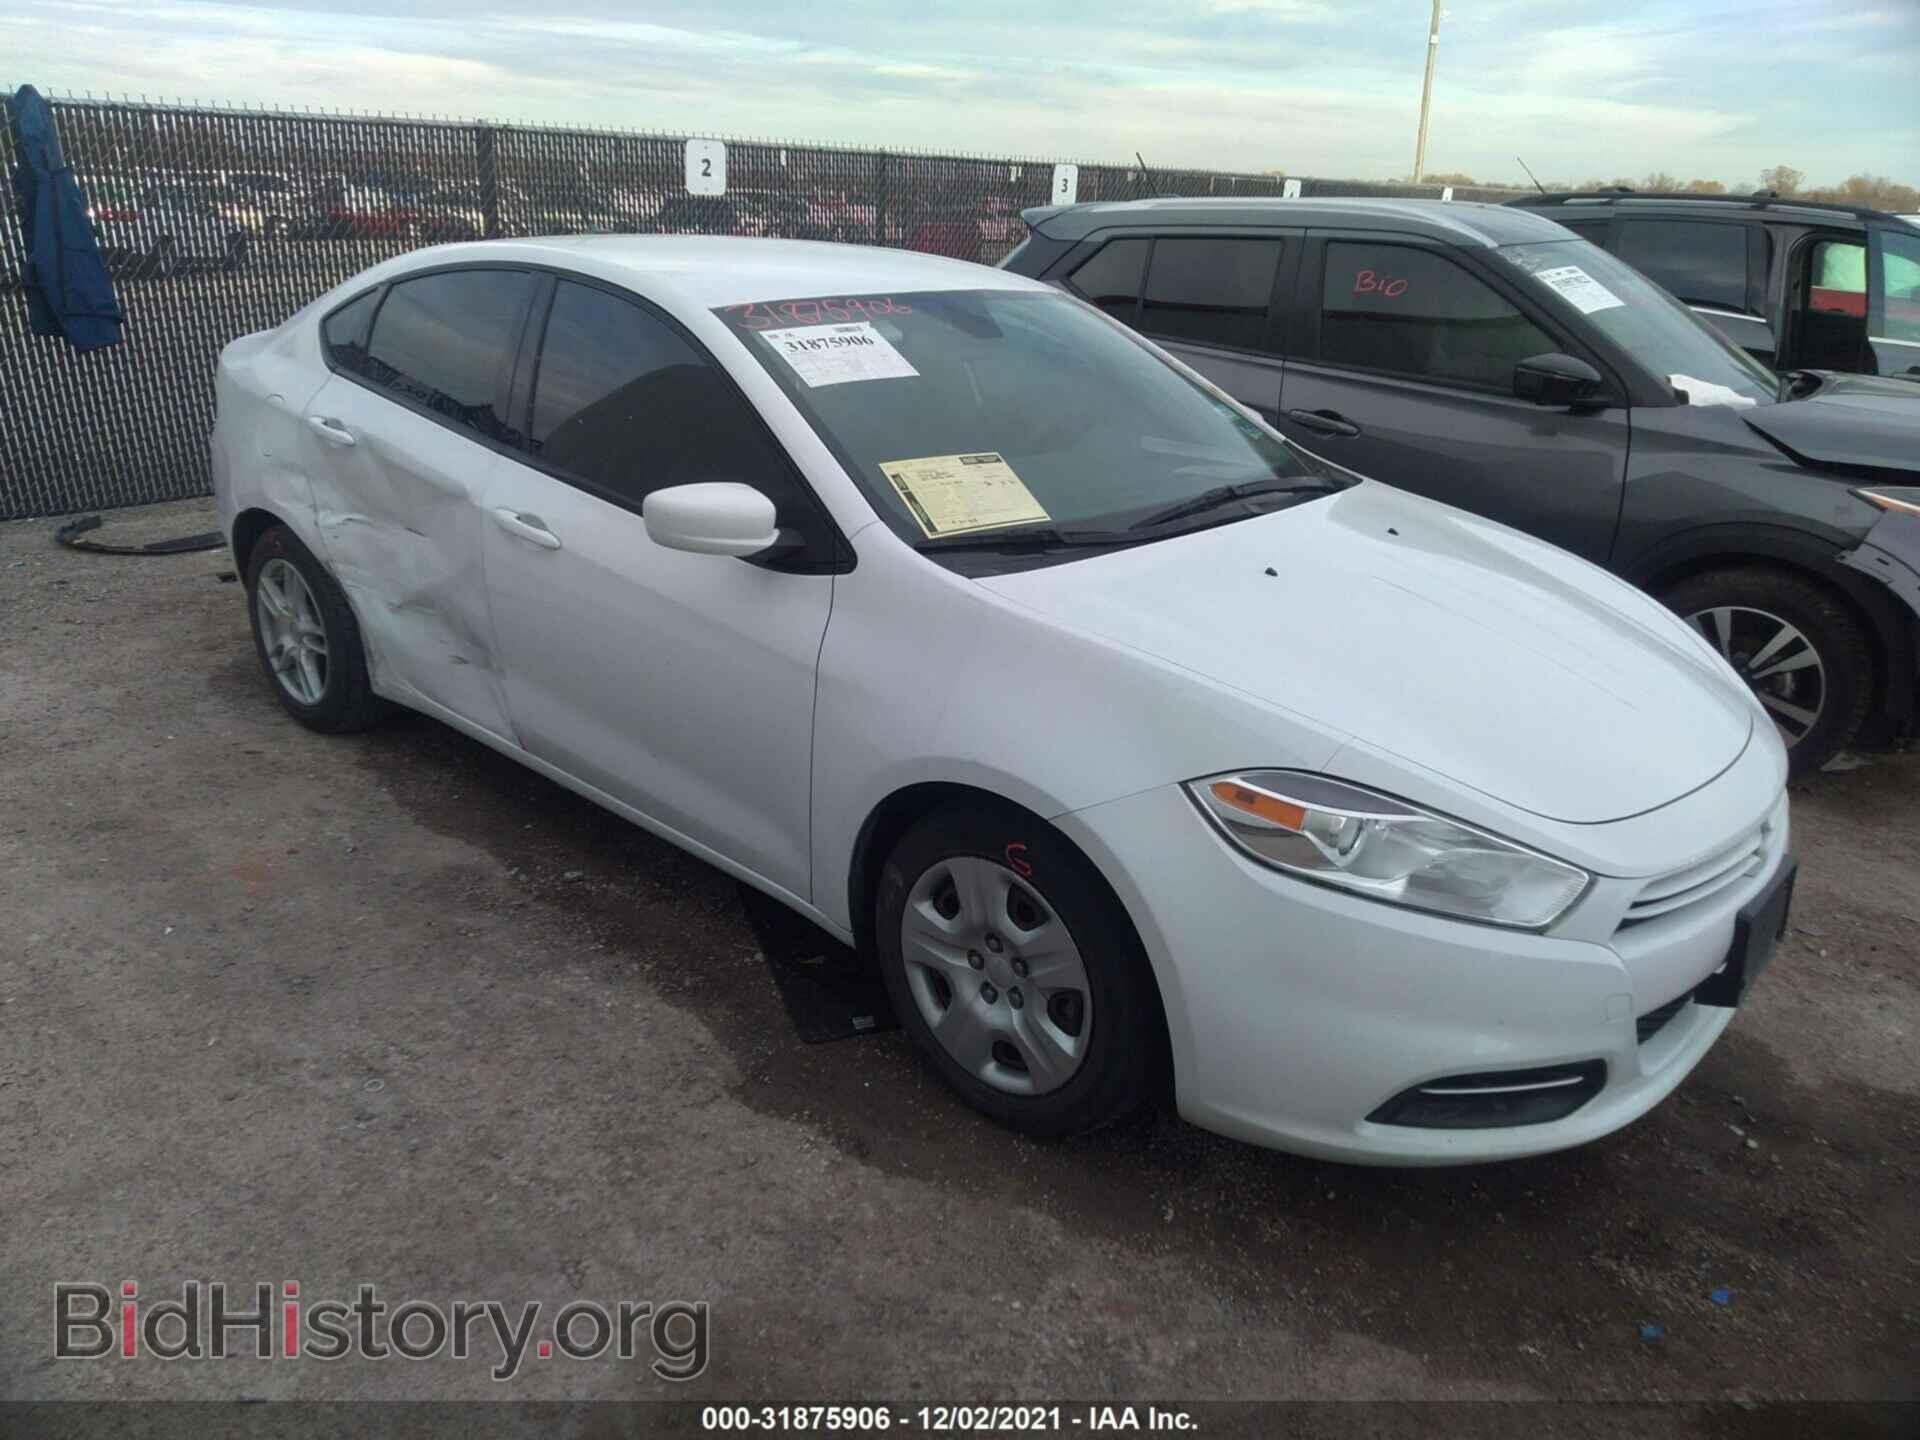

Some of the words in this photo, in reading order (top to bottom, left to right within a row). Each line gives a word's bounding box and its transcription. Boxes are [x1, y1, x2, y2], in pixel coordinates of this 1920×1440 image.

[701, 158, 712, 177] 2
[1060, 178, 1069, 193] 3
[784, 335, 875, 354] 31875906
